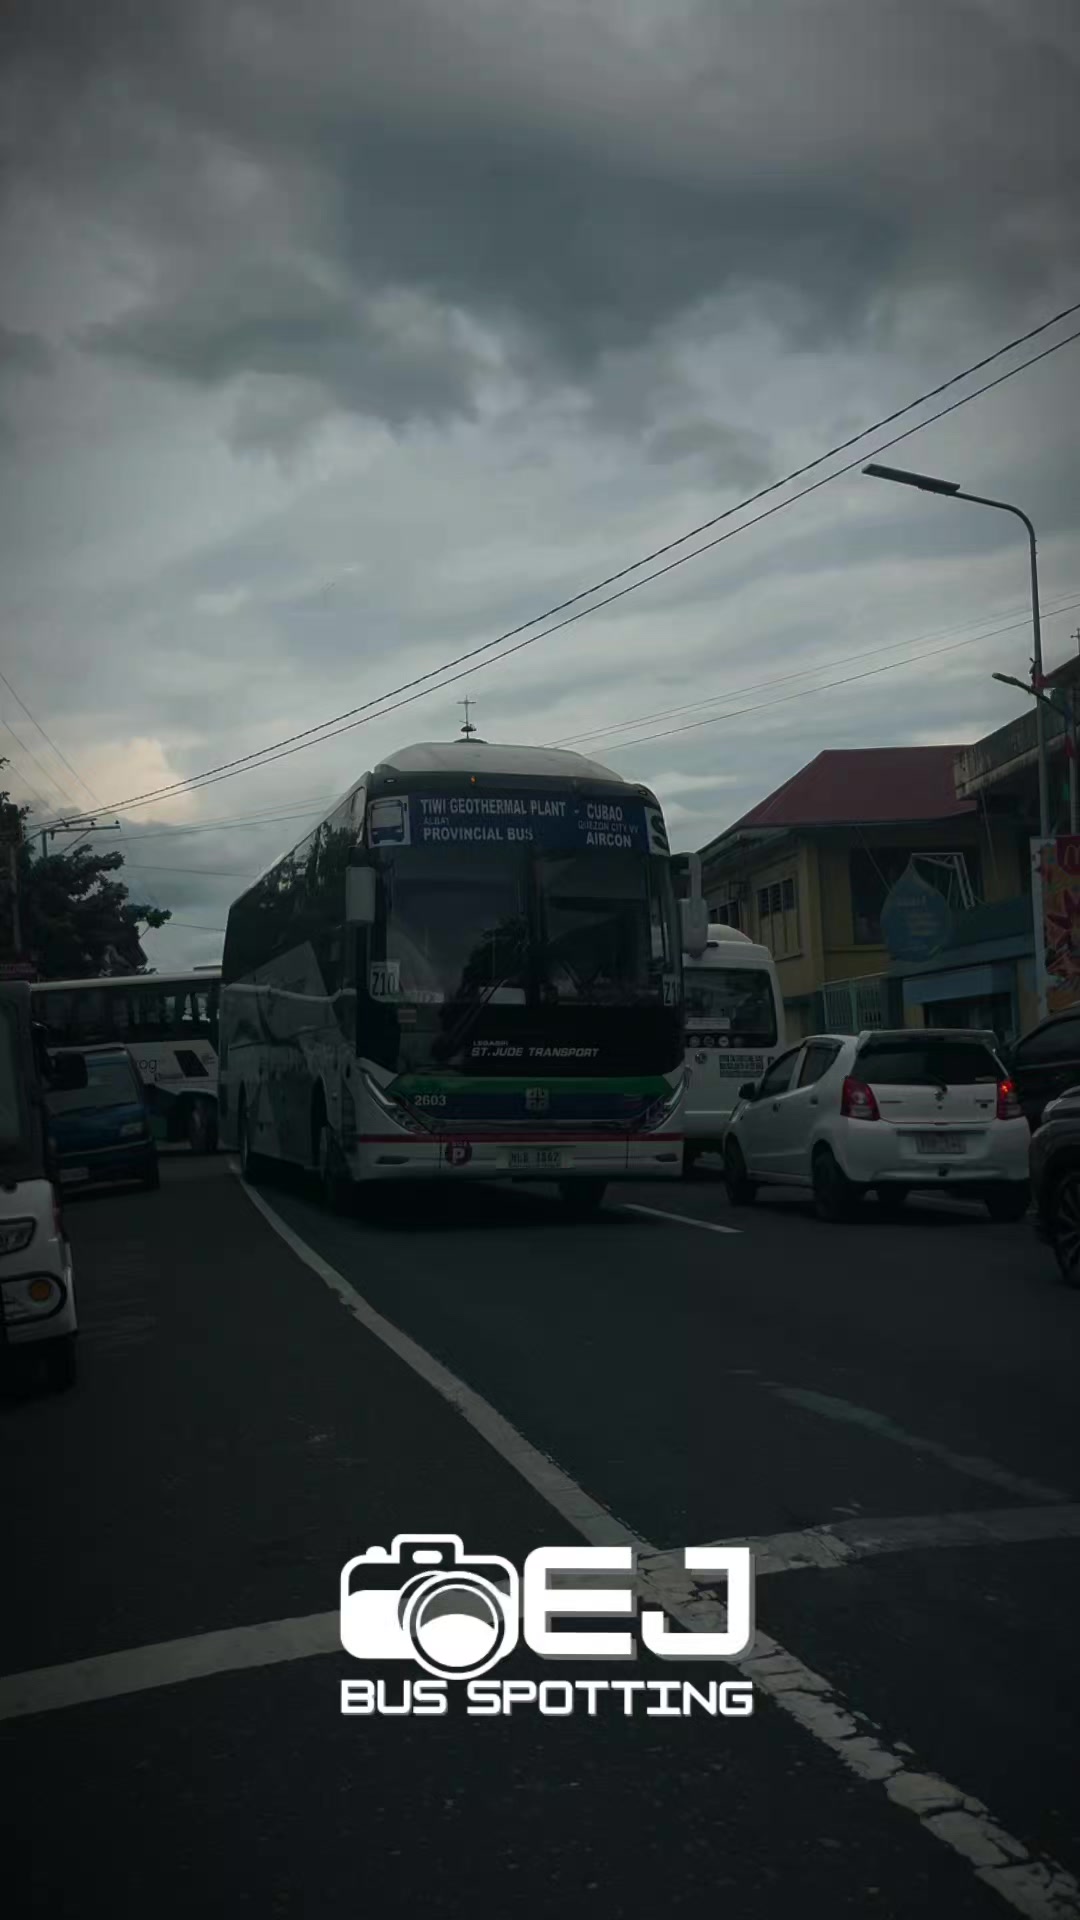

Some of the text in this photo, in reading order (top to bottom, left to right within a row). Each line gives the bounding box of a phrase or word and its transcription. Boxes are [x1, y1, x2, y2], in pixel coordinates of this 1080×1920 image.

[420, 798, 447, 815] TIWI
[449, 798, 528, 815] GEOTHERMAL
[529, 799, 566, 817] PLANT
[586, 803, 623, 821] CUBAO
[423, 827, 534, 841] PROVINCIAL BUS
[611, 822, 627, 833] CITY
[586, 832, 632, 848] AIRCON
[528, 1047, 599, 1058] TRANSPORT
[415, 1094, 448, 1107] 2603
